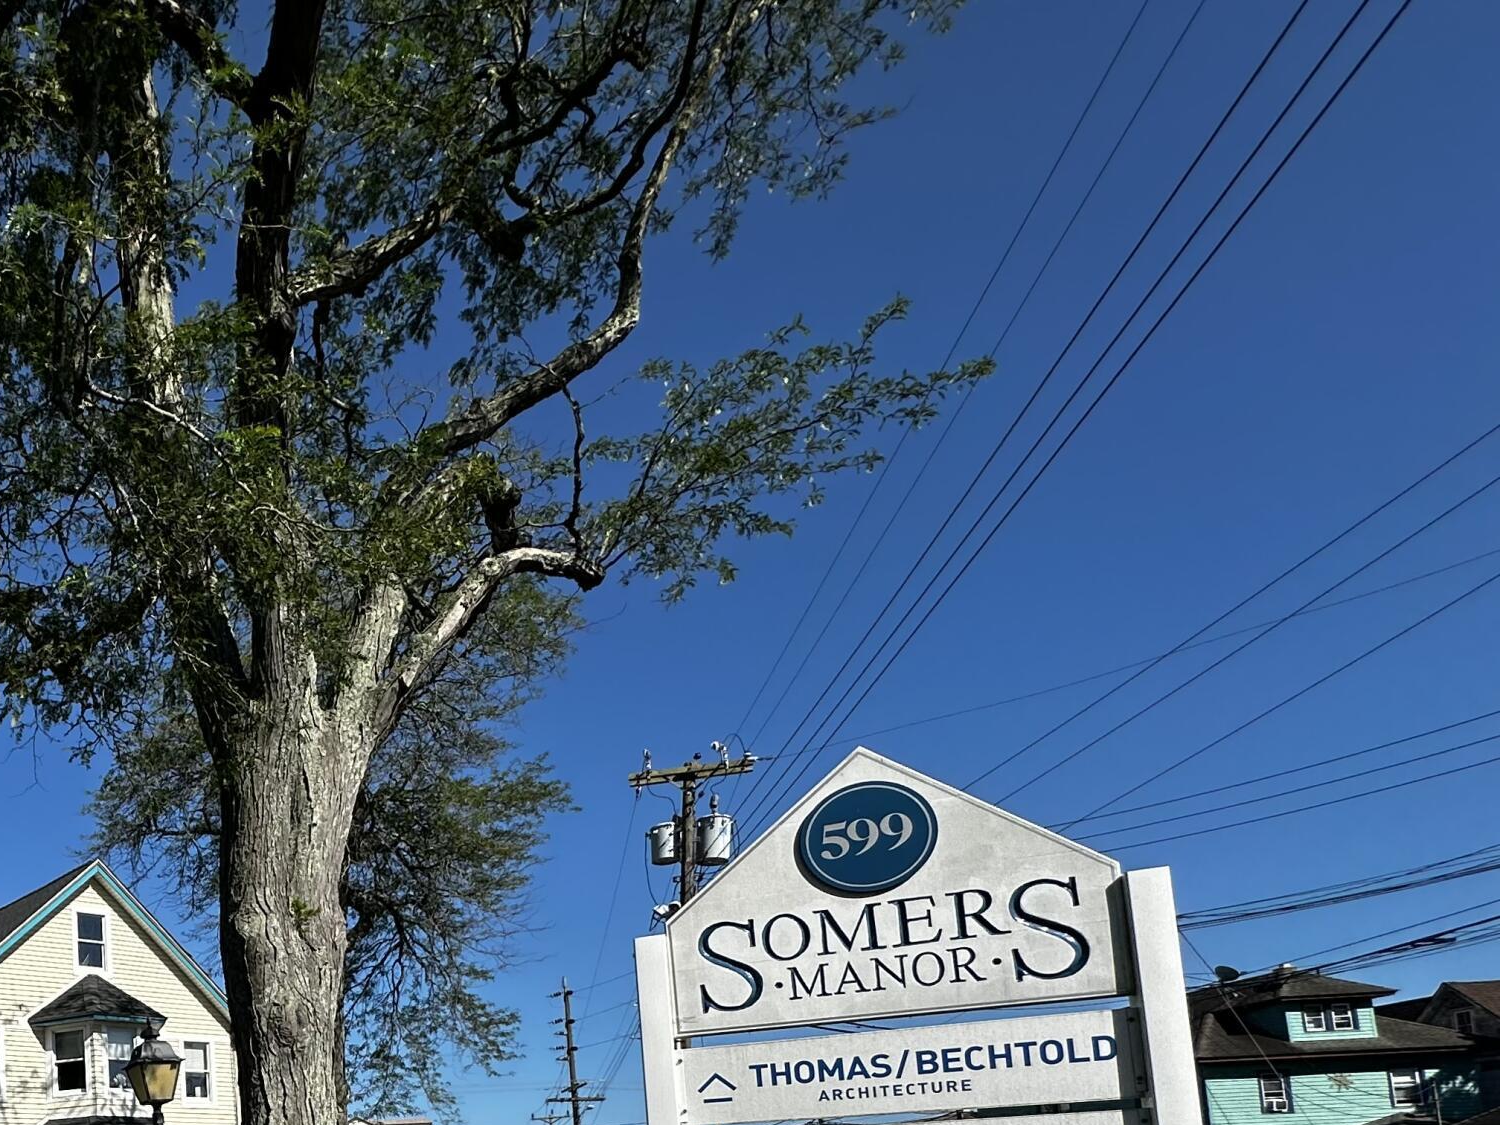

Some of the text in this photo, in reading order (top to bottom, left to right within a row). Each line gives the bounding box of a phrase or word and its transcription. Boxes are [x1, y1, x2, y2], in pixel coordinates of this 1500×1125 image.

[820, 812, 914, 861] 599
[698, 875, 1091, 1014] SOMERS
[749, 1034, 1118, 1088] THOMAS/BECHTOLD
[818, 1078, 972, 1102] ARCHITECTURE
